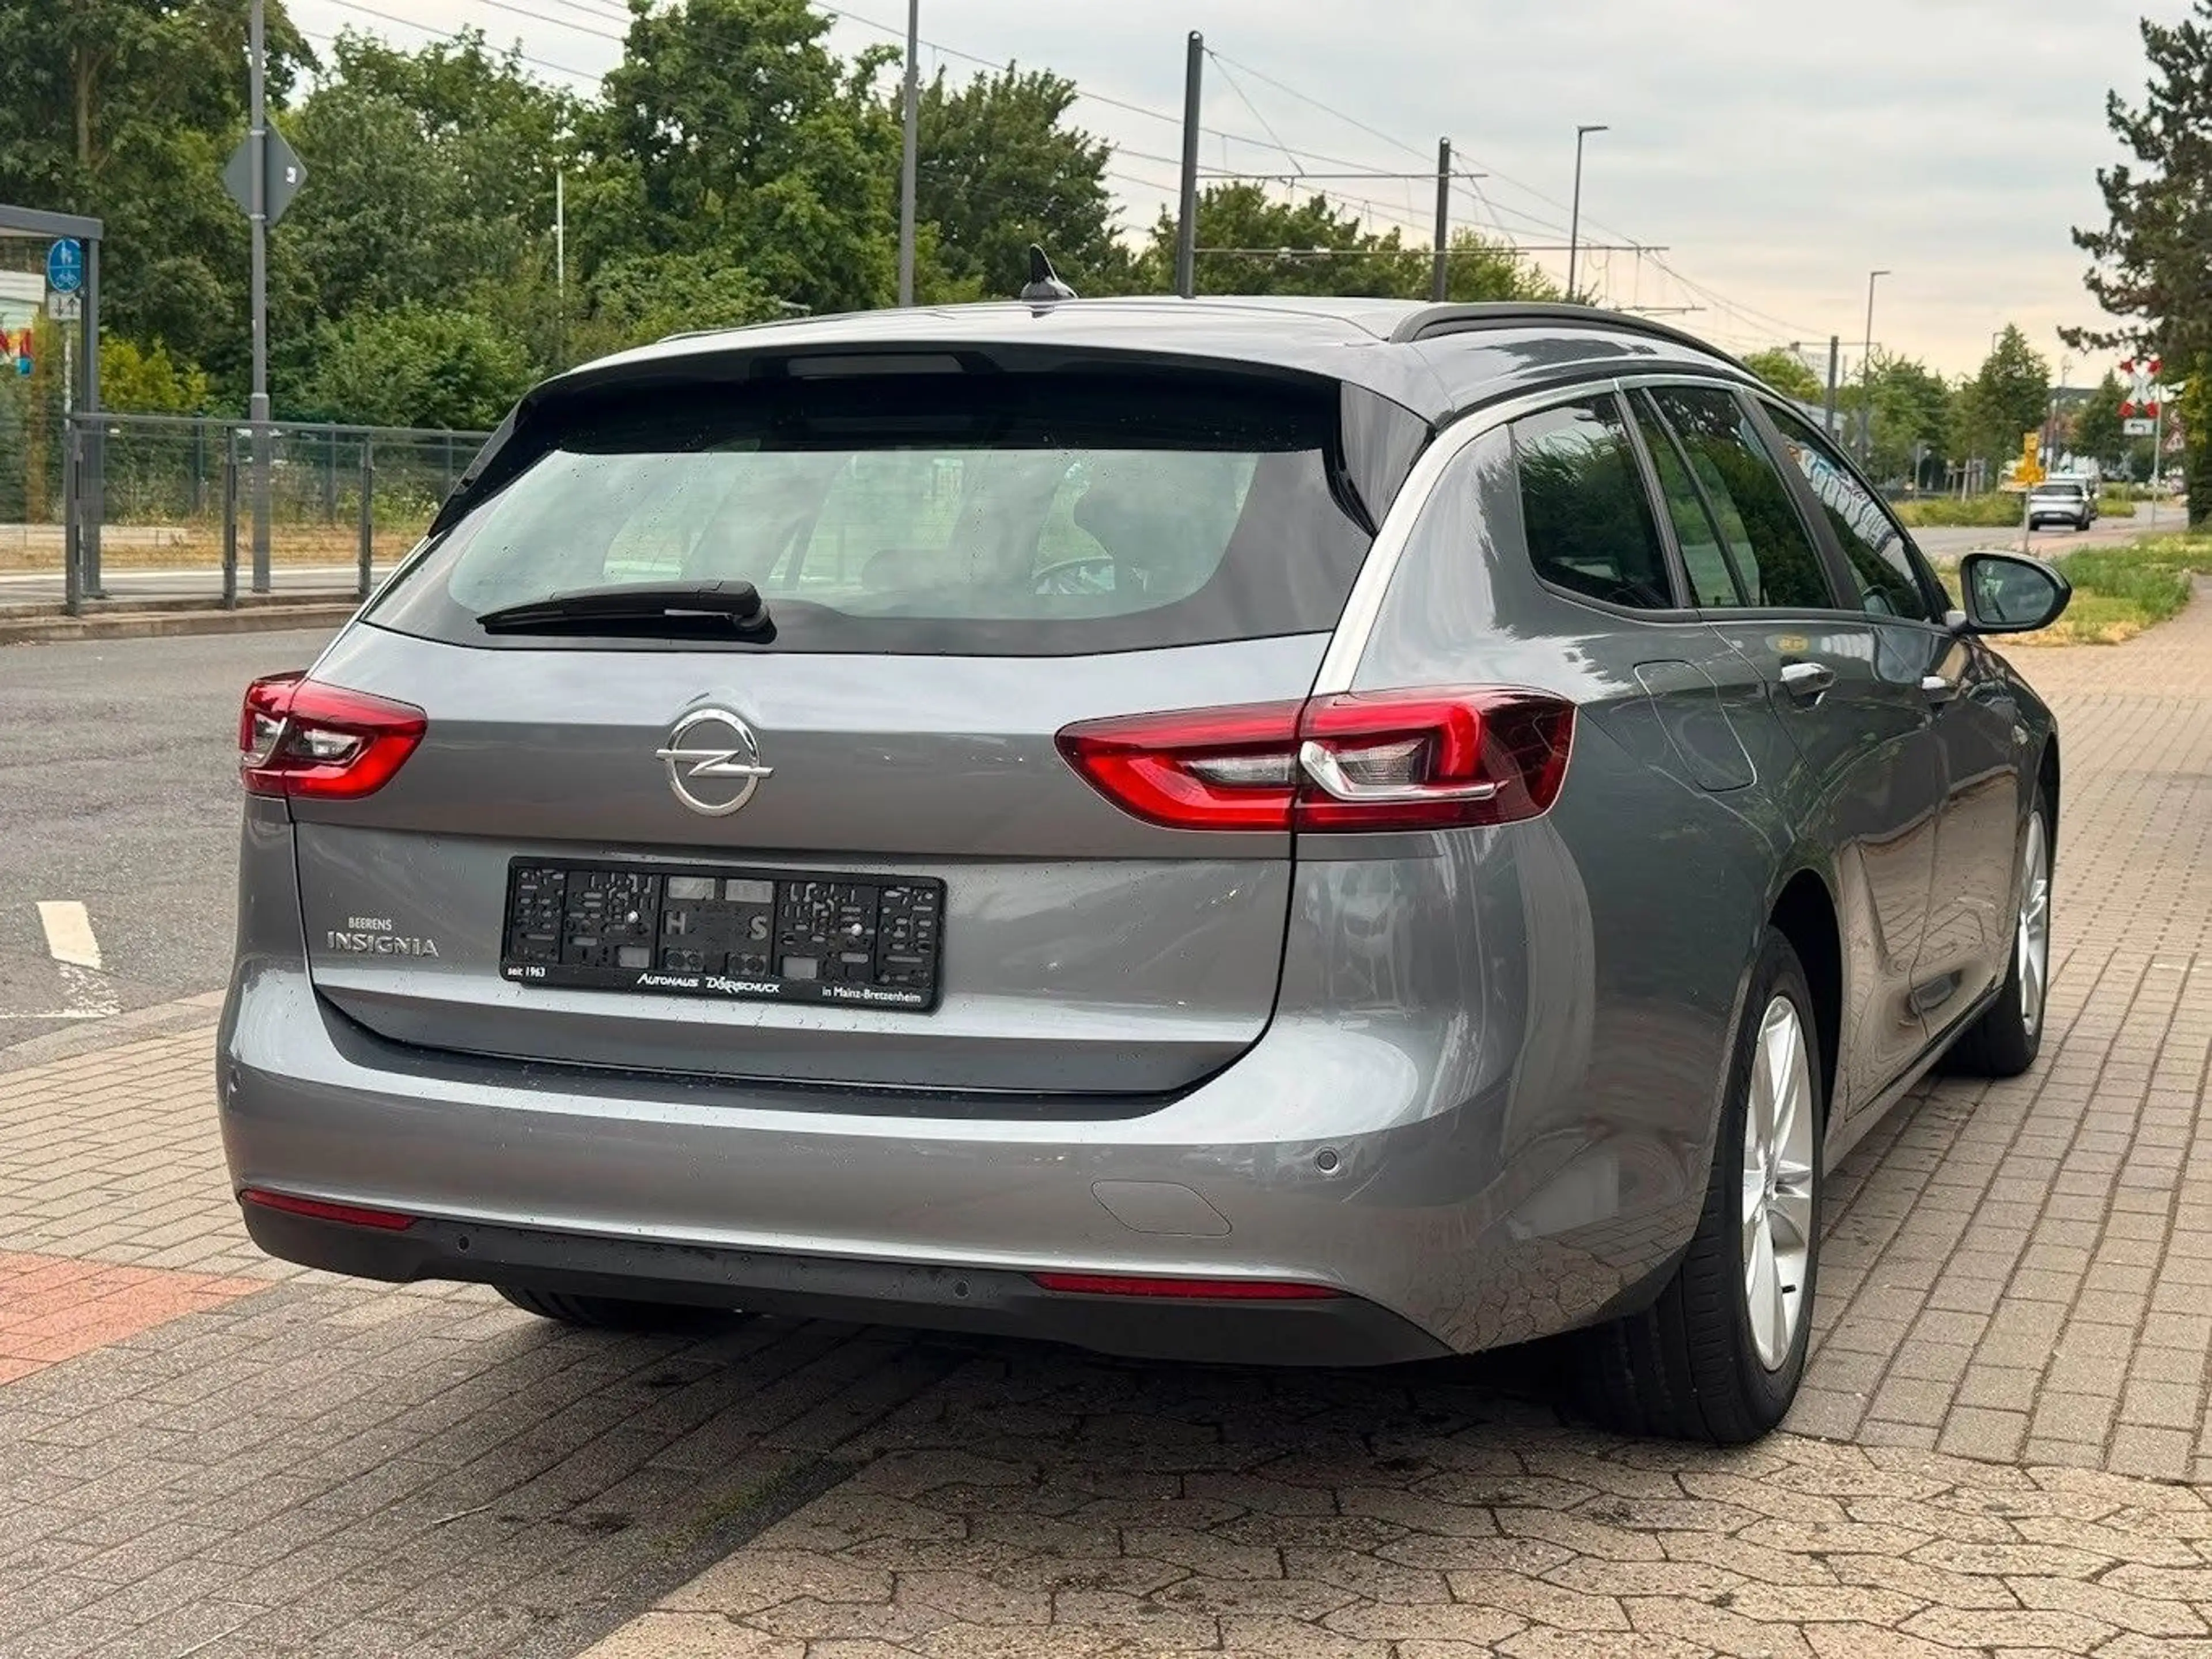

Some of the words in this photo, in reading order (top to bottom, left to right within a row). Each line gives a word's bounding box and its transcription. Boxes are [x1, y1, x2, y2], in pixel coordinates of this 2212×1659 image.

[348, 916, 392, 931] BEERENS
[327, 930, 440, 957] INSIGNIA
[525, 967, 546, 978] 1963
[821, 986, 832, 997] in
[833, 986, 922, 1003] Mainz-Bretzenheim
